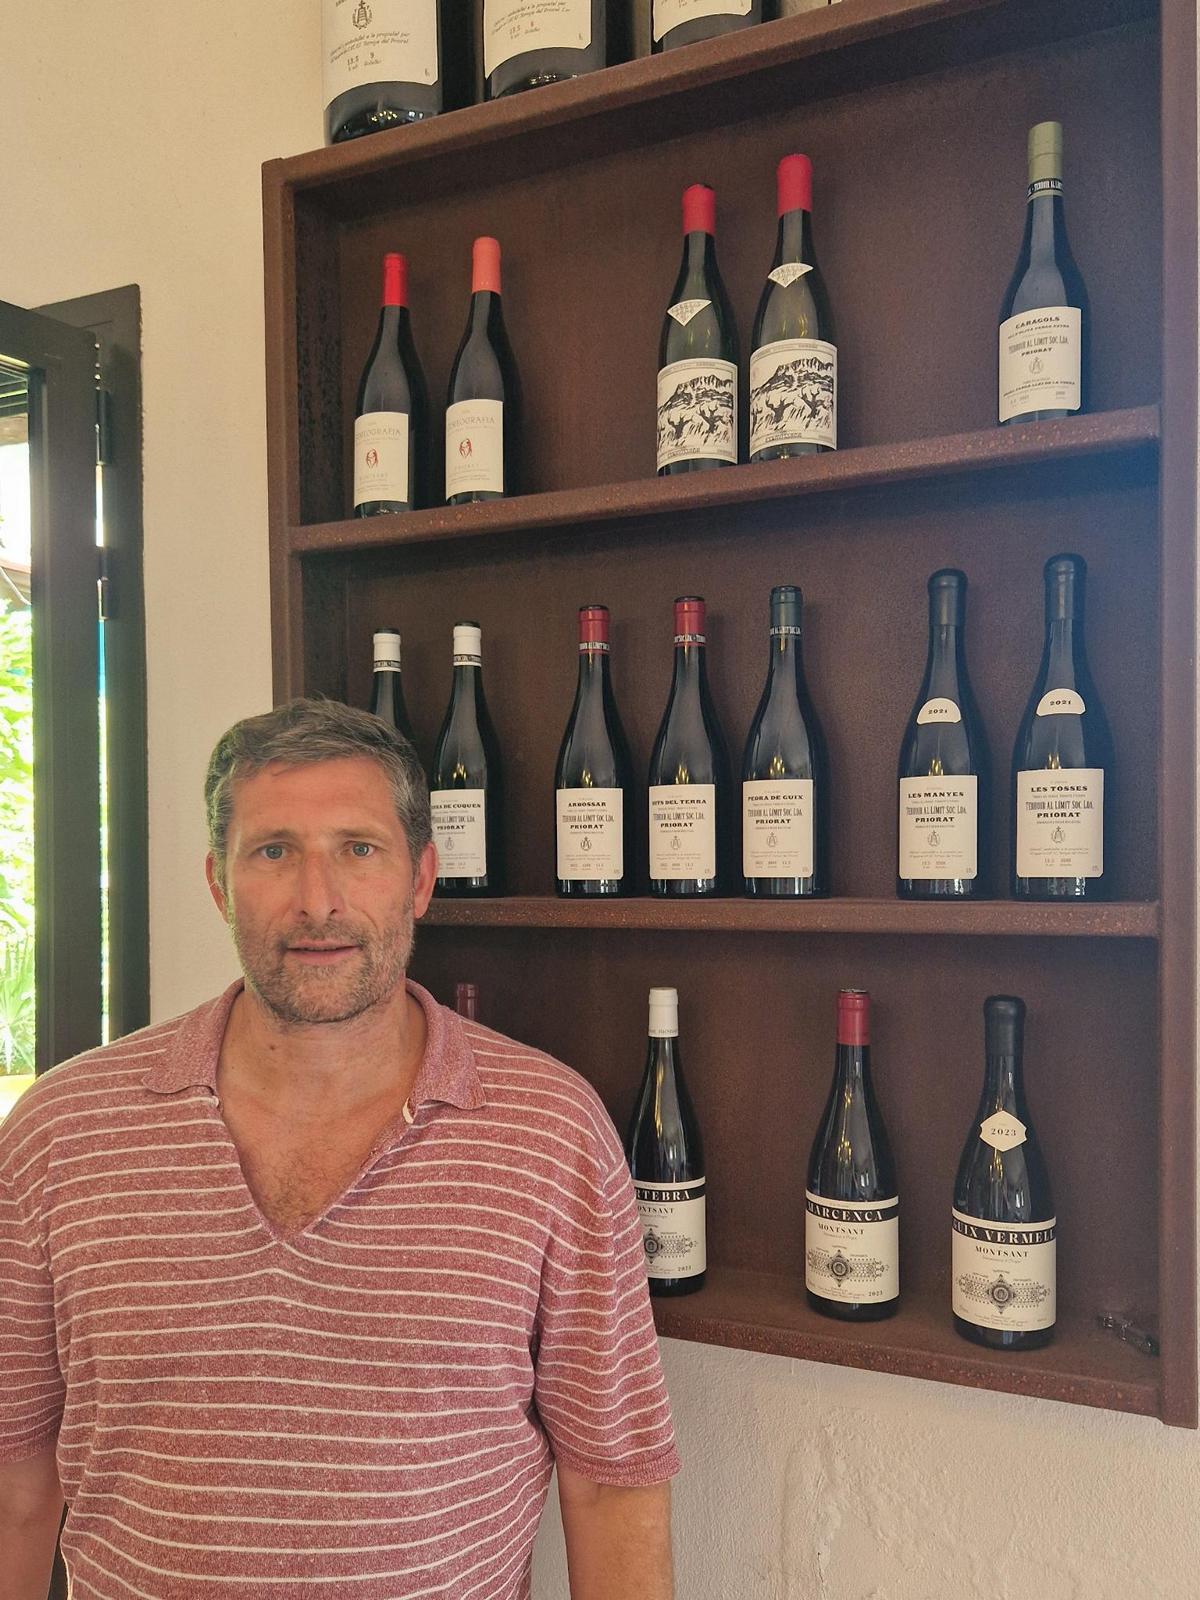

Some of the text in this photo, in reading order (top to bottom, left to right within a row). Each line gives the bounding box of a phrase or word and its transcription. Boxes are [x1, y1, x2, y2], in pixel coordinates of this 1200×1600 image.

[1015, 316, 1060, 329] CARAGOLS
[1021, 347, 1052, 356] PRIORAT
[923, 791, 965, 799] MANYES
[990, 1128, 1018, 1137] 2023
[818, 1223, 865, 1236] MONTSANT
[975, 1245, 1029, 1258] MONTSANT
